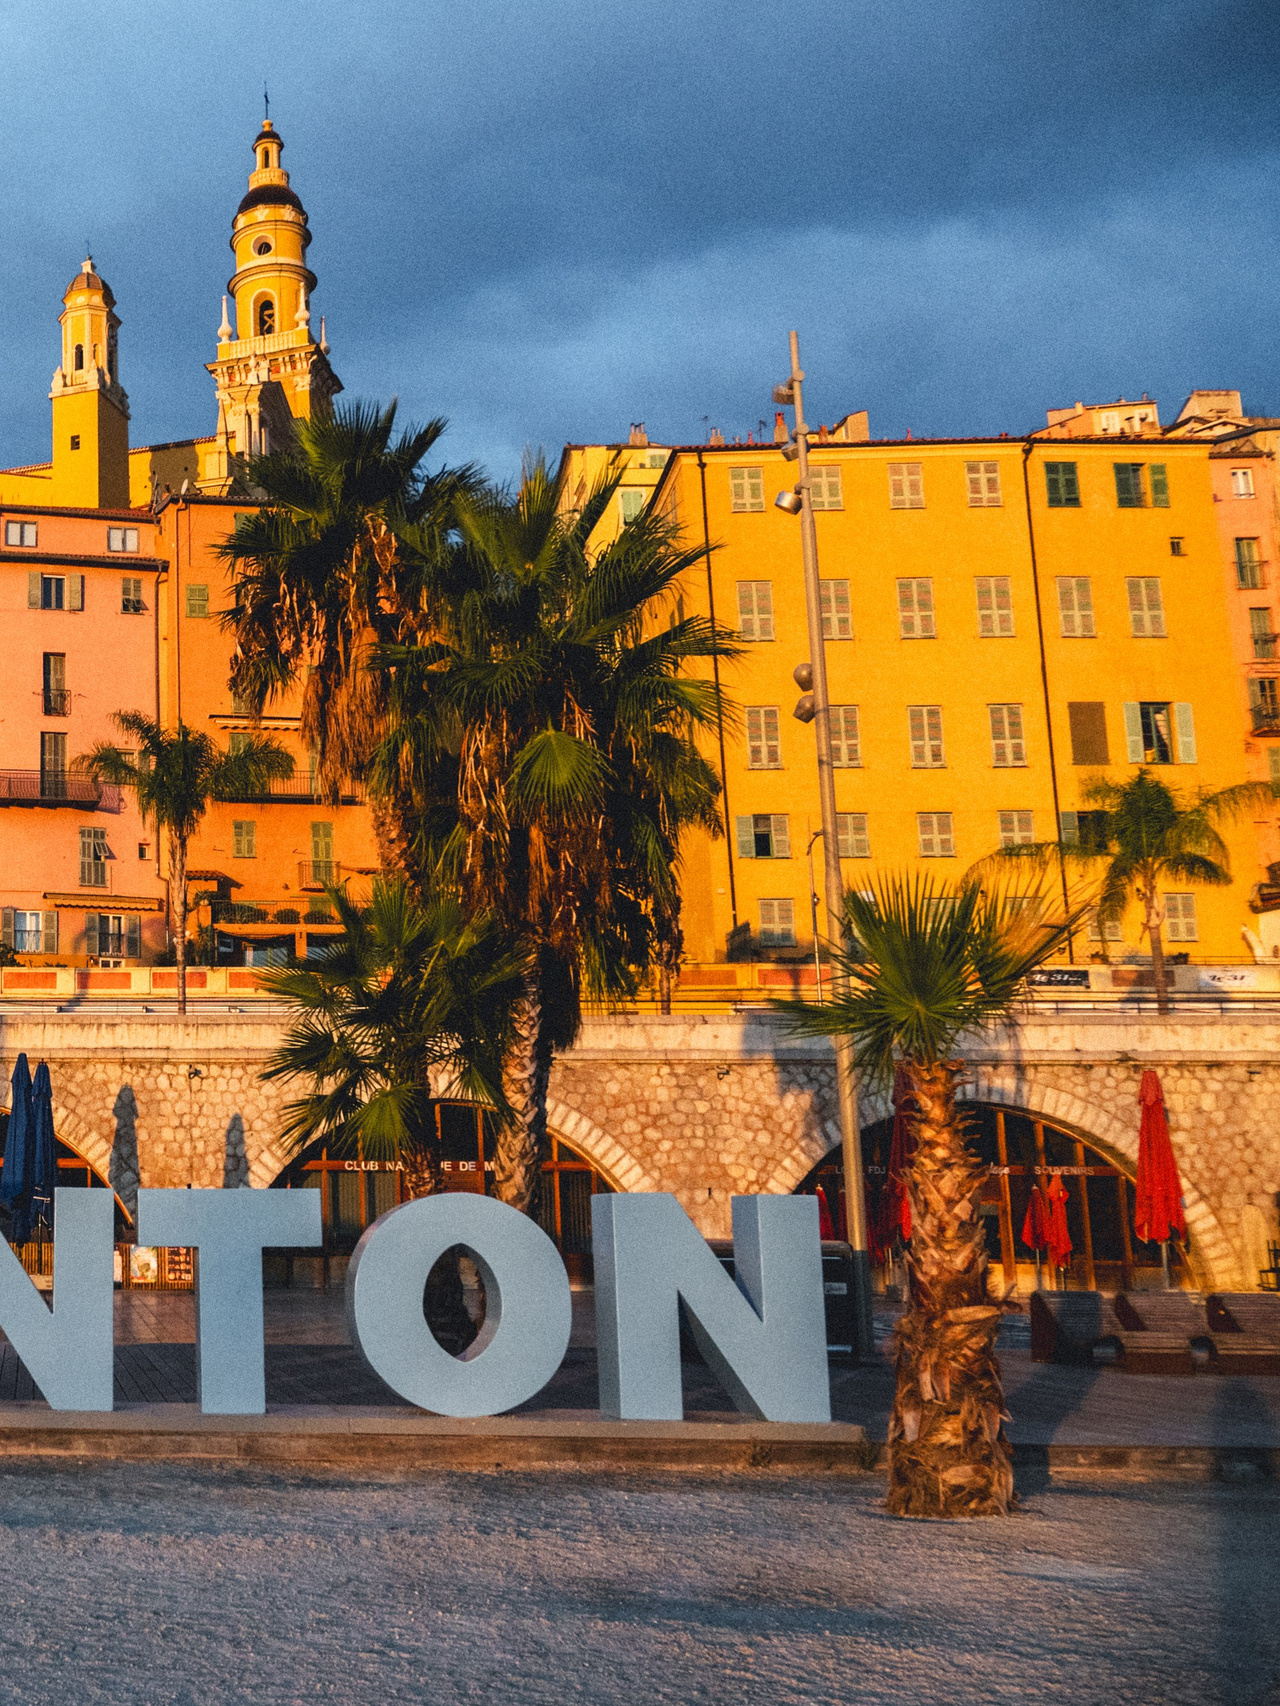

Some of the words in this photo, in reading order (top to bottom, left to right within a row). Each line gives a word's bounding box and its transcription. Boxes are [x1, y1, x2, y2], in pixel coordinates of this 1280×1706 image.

[344, 1160, 379, 1171] CLUB
[459, 1160, 477, 1172] DE
[868, 1166, 886, 1174] FDJ
[1034, 1166, 1096, 1176] SOUVENIRS
